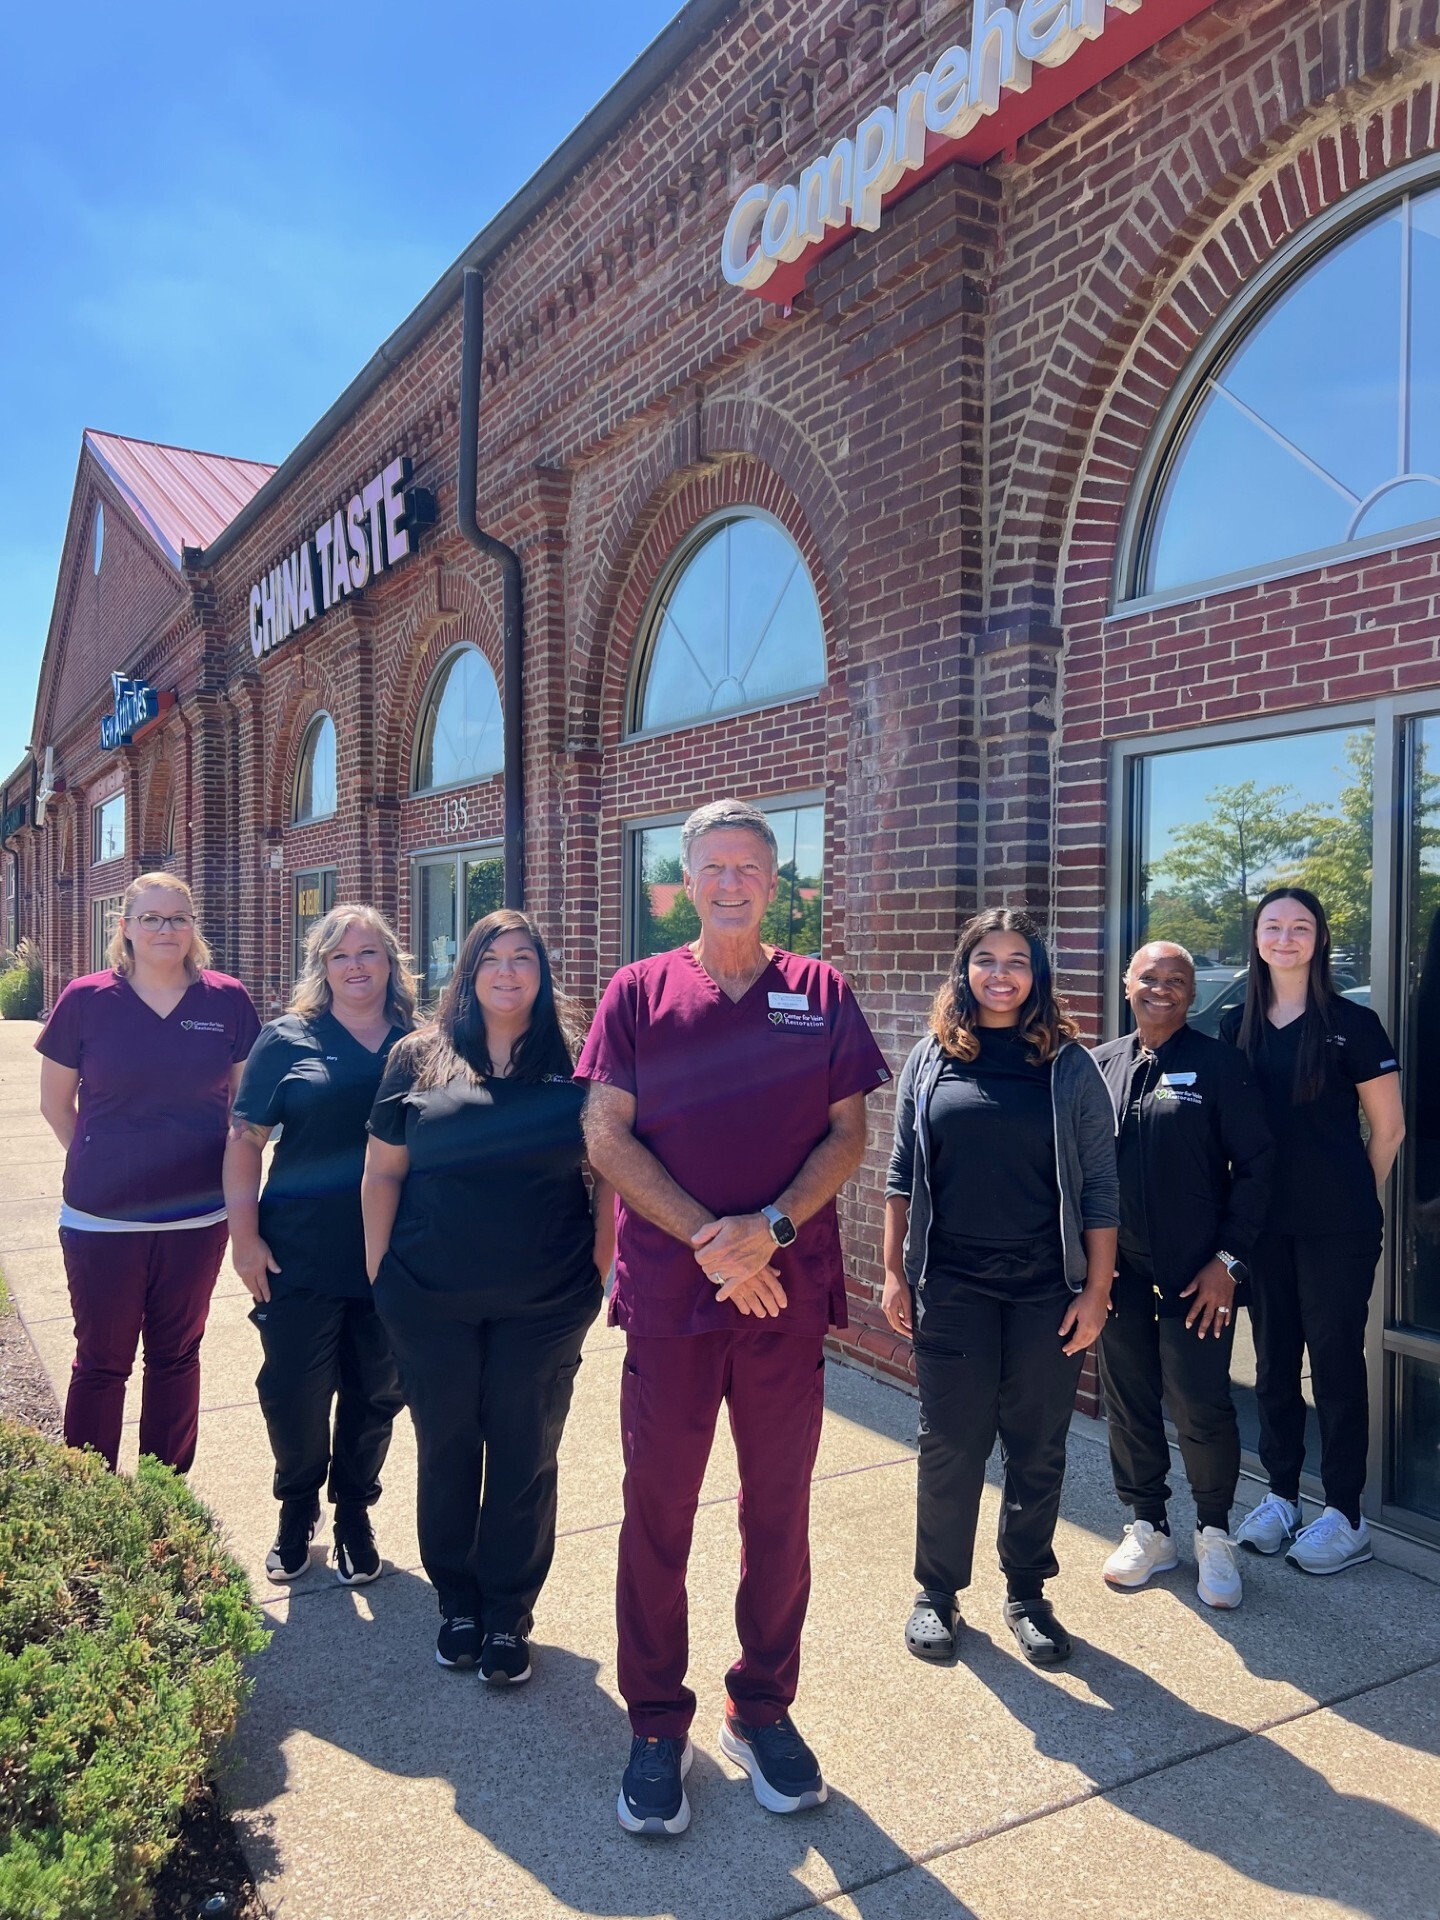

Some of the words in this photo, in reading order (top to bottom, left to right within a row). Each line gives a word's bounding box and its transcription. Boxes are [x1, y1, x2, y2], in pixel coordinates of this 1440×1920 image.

[249, 540, 319, 659] CHINA
[315, 455, 410, 611] TASTE
[443, 796, 467, 832] 135
[783, 1012, 801, 1020] Center
[785, 1019, 824, 1027] Restoration
